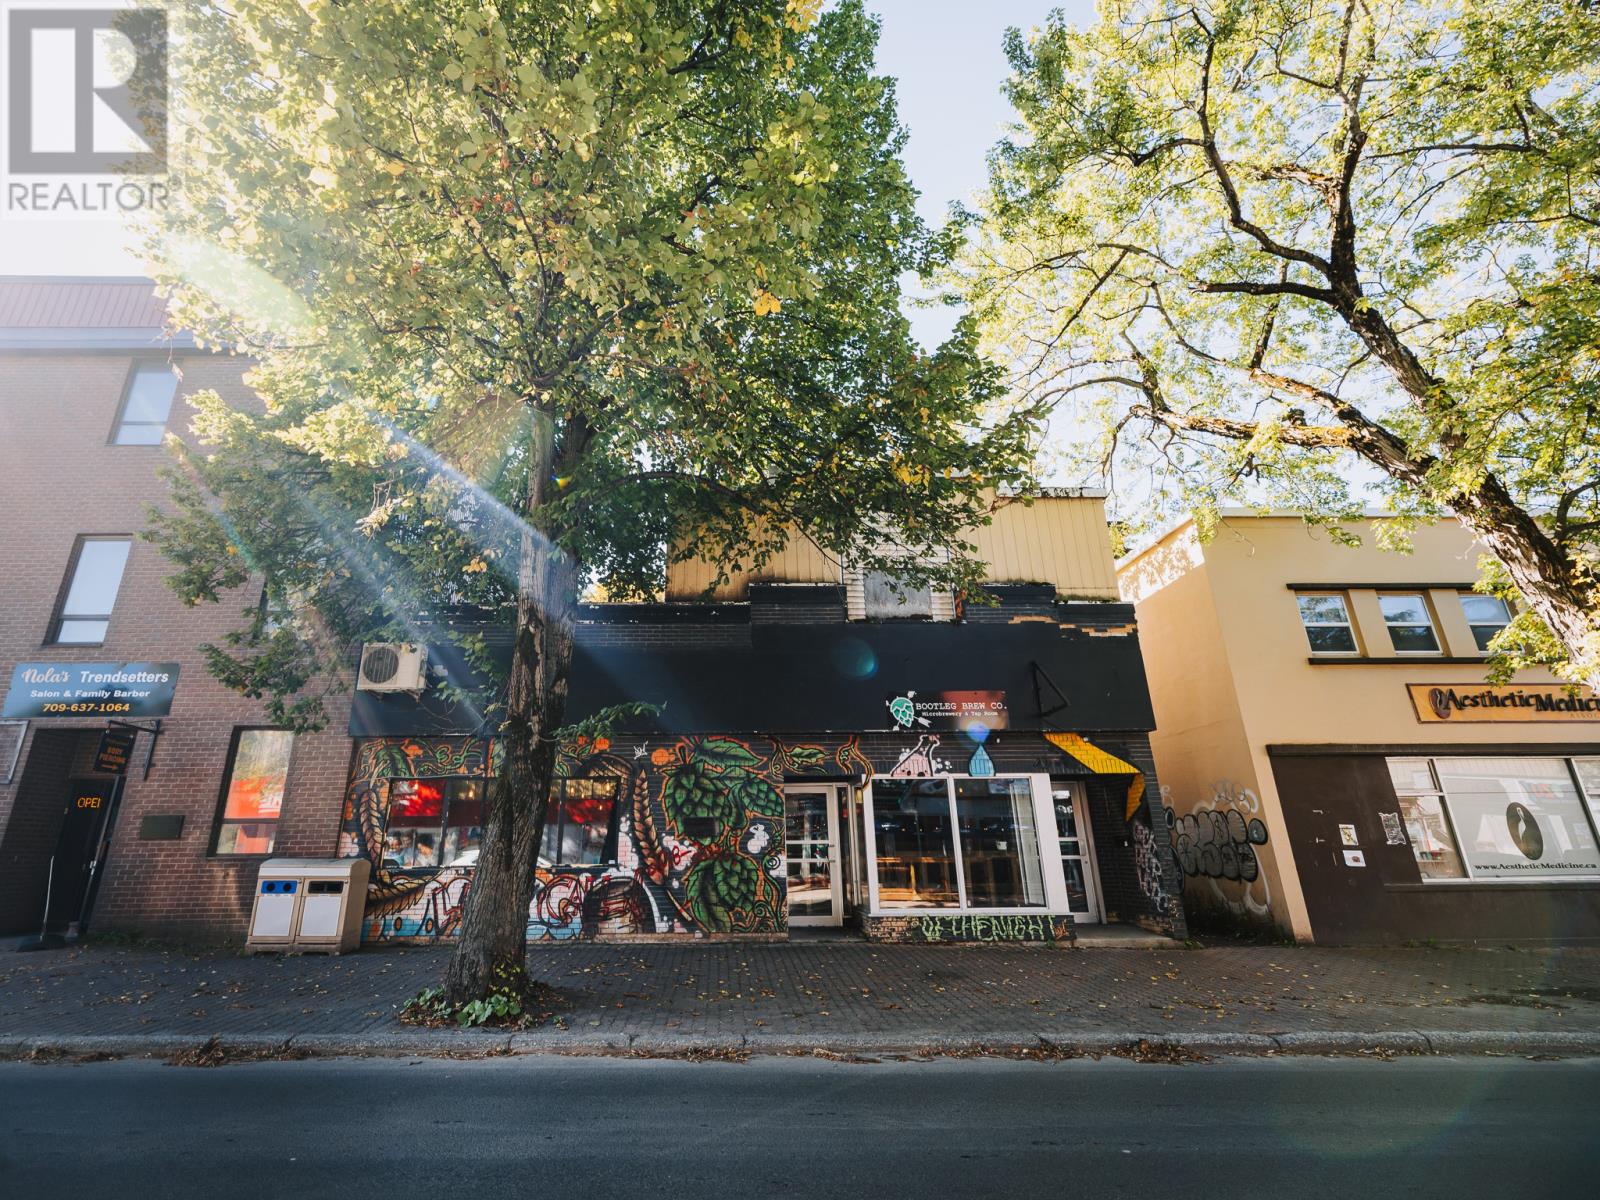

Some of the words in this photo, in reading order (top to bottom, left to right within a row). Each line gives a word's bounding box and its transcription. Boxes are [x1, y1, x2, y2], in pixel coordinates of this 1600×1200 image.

[22, 667, 70, 684] Nola's
[80, 670, 169, 683] Trendsetters
[30, 690, 60, 698] Salon
[63, 690, 72, 698] &
[75, 690, 111, 699] Family
[113, 690, 150, 698] Barber
[43, 703, 131, 712] 709-637-1064
[915, 702, 957, 710] BOOTLEG
[962, 702, 985, 710] BREW
[990, 702, 1008, 710] CO.
